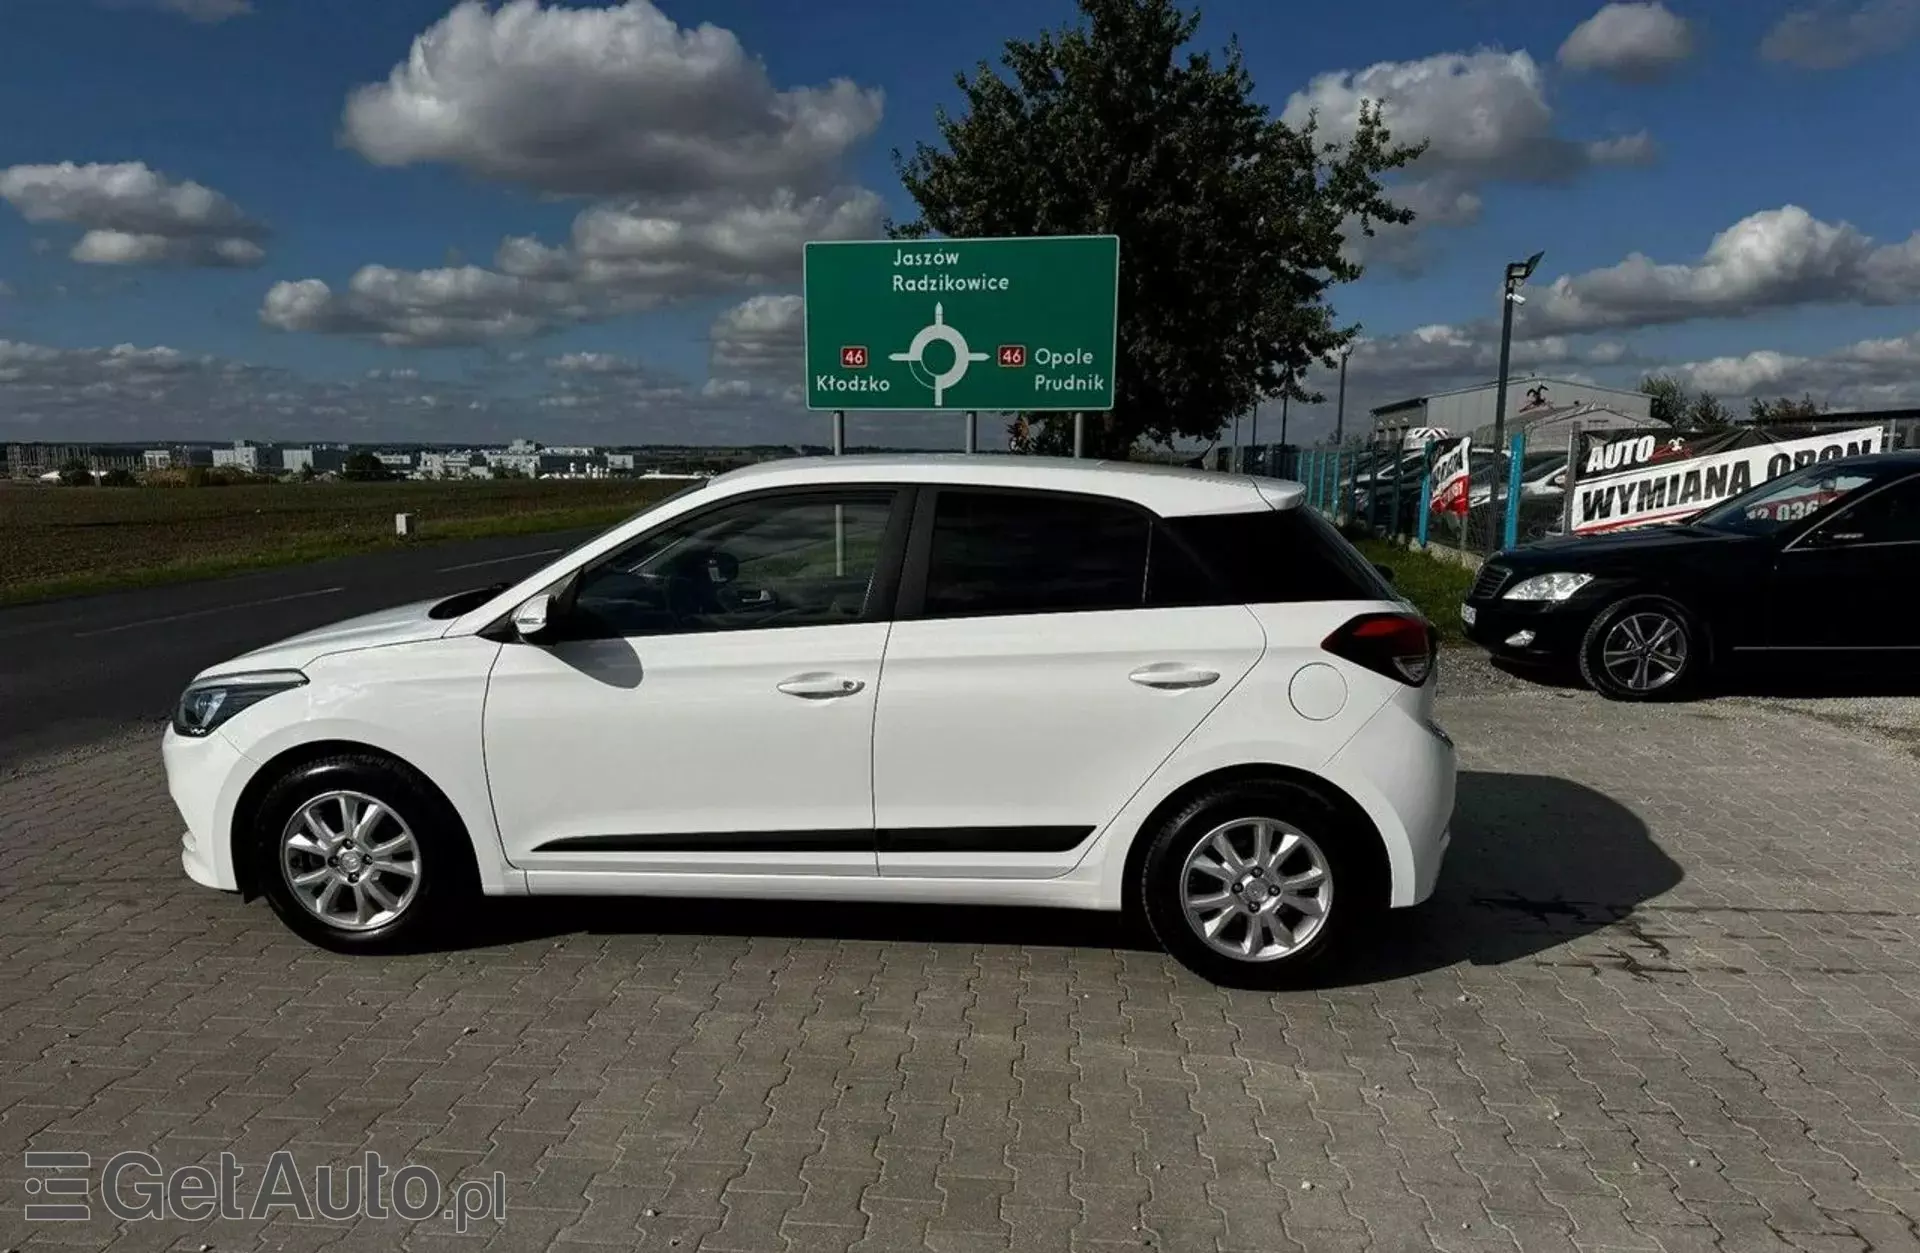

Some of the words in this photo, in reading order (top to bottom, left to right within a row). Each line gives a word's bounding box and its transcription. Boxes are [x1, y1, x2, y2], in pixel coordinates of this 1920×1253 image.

[893, 248, 960, 267] Jaszów
[892, 274, 1010, 292] Radzikowice
[844, 350, 863, 364] 46
[1002, 349, 1021, 363] 46
[1034, 348, 1094, 369] Opole
[816, 375, 891, 392] Kłodzko
[1034, 374, 1105, 391] Prudnik
[1585, 435, 1656, 474] AUTO
[1582, 460, 1752, 522] WYMIANA
